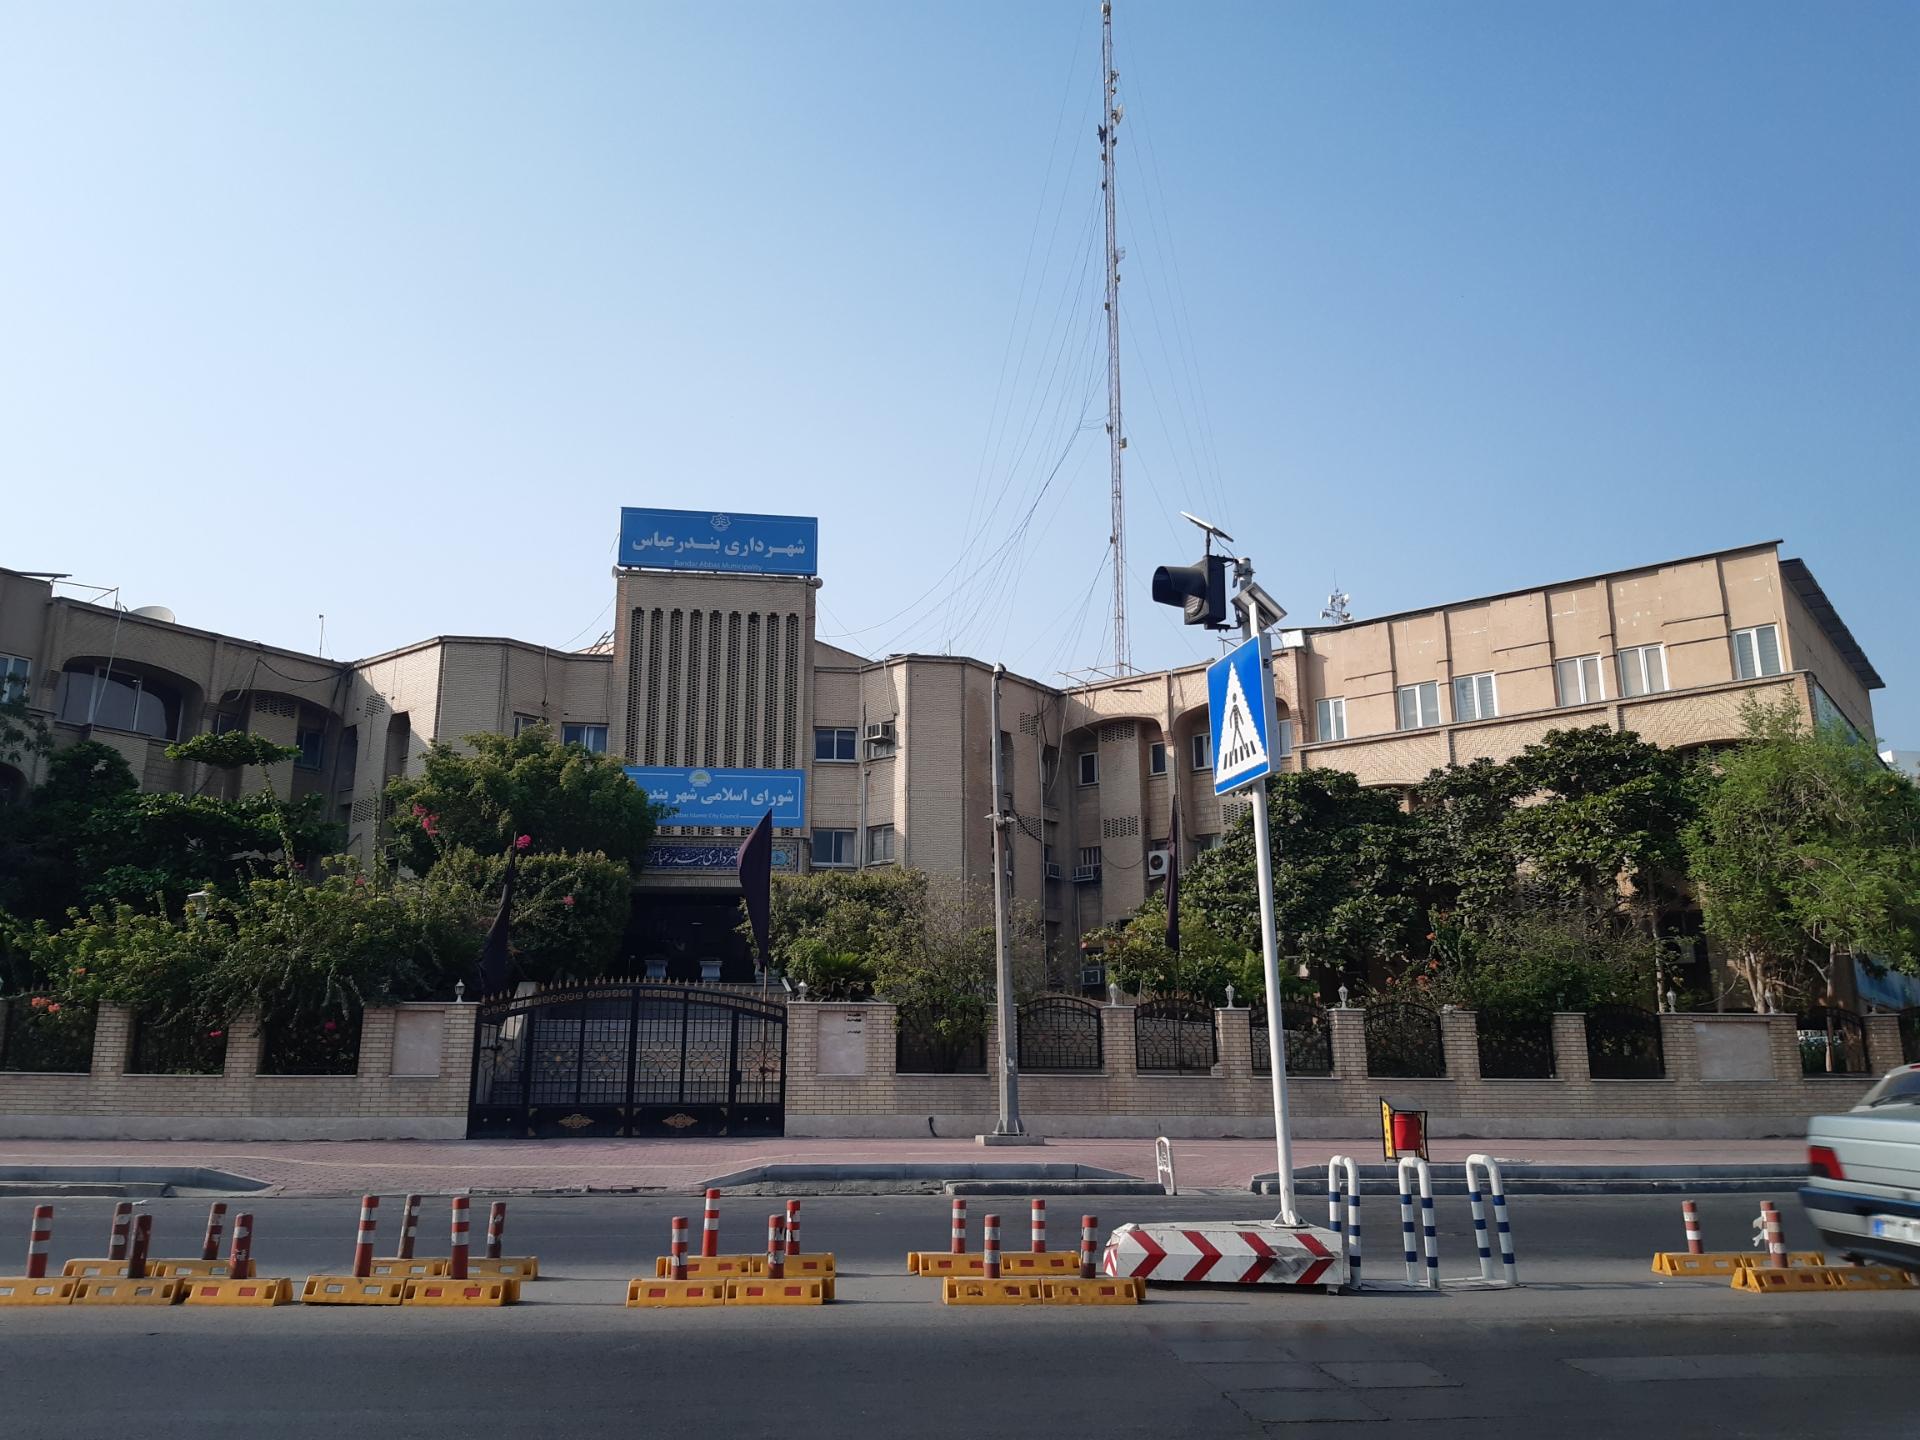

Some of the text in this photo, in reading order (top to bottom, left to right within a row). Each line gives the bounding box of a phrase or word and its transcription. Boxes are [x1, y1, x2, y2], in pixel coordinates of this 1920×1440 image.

[674, 559, 698, 568] Bandar
[672, 787, 697, 804] شهر
[700, 787, 748, 804] اسلامی
[750, 789, 794, 806] شورای
